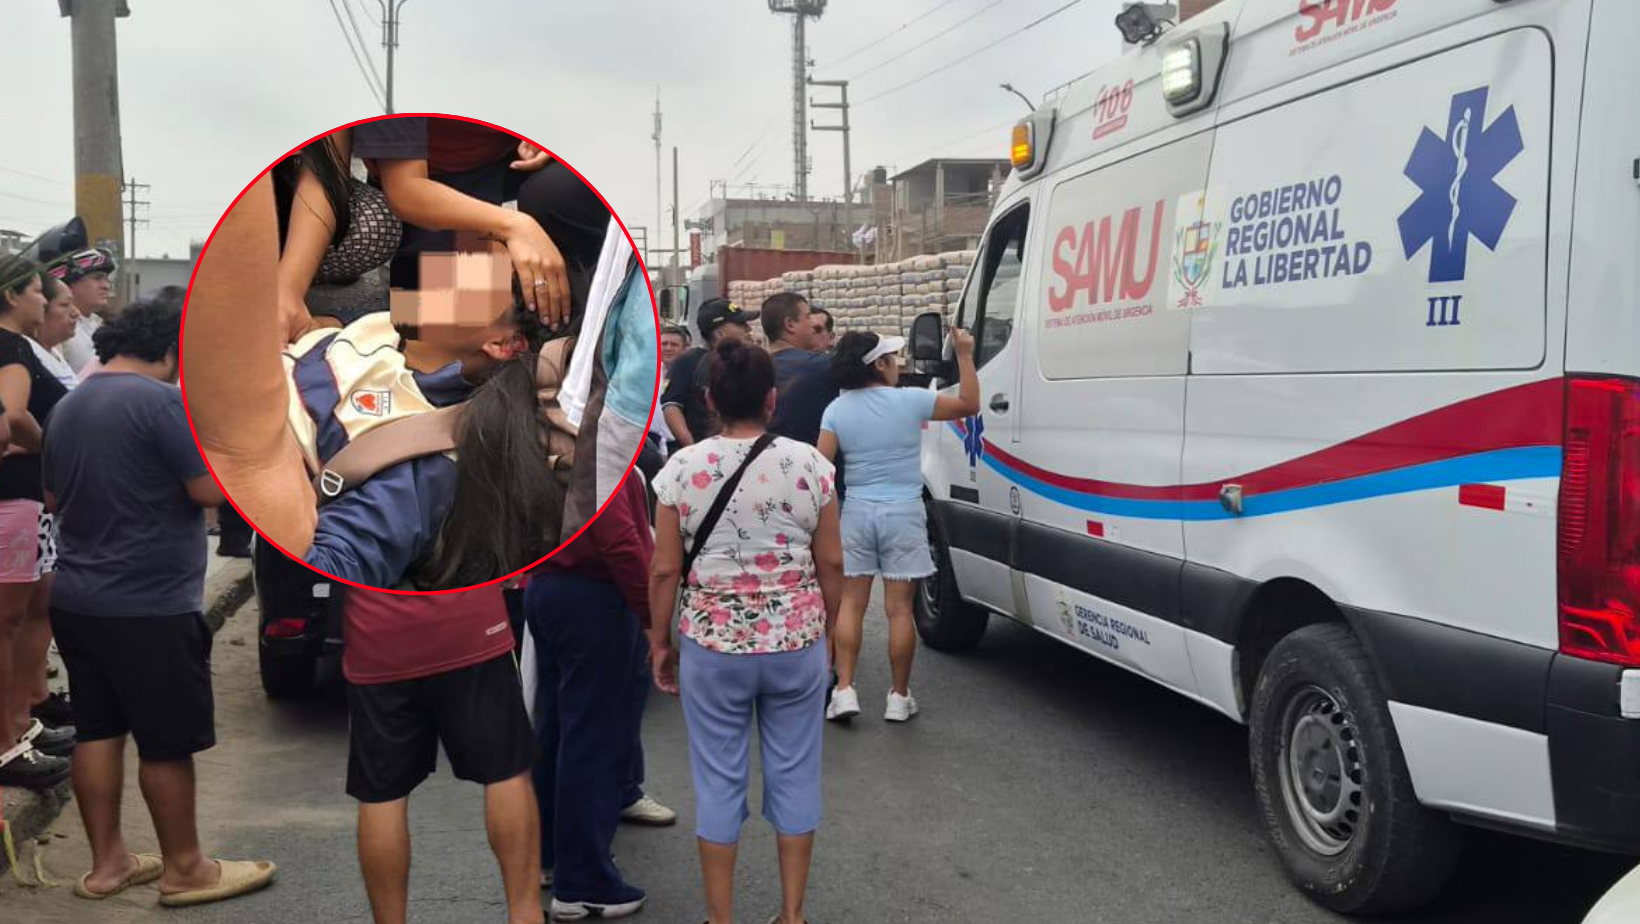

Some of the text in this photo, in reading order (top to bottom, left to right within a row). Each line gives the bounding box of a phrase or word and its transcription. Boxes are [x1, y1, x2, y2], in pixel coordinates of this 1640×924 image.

[1230, 174, 1342, 223] GOBIERNO
[1048, 199, 1165, 313] SAMU
[1226, 208, 1345, 257] REGIONAL
[1222, 241, 1372, 289] LA LIBERTAD
[1426, 295, 1462, 327] III
[1090, 625, 1119, 650] SALUD
[1110, 618, 1151, 645] REGIONAL
